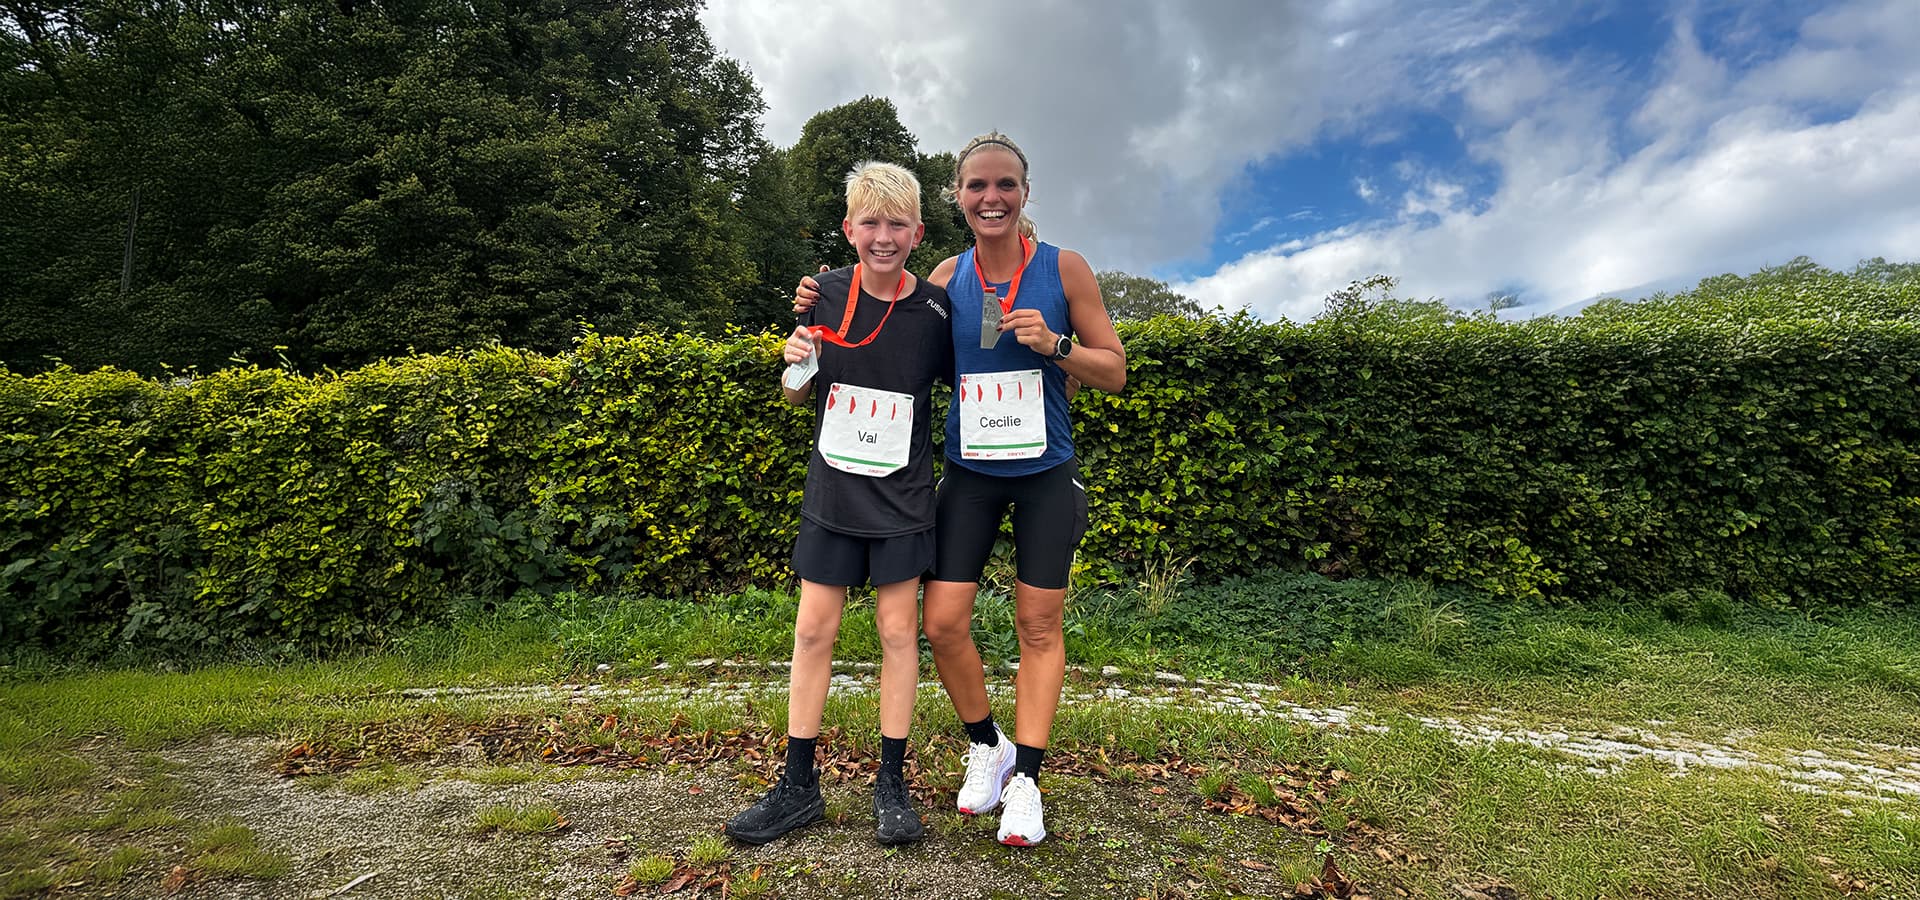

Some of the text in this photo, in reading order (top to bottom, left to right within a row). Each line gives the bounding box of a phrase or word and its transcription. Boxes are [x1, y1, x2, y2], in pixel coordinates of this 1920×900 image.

[926, 298, 948, 320] FUSION
[980, 416, 1022, 428] Cecilie
[858, 430, 878, 444] Val
